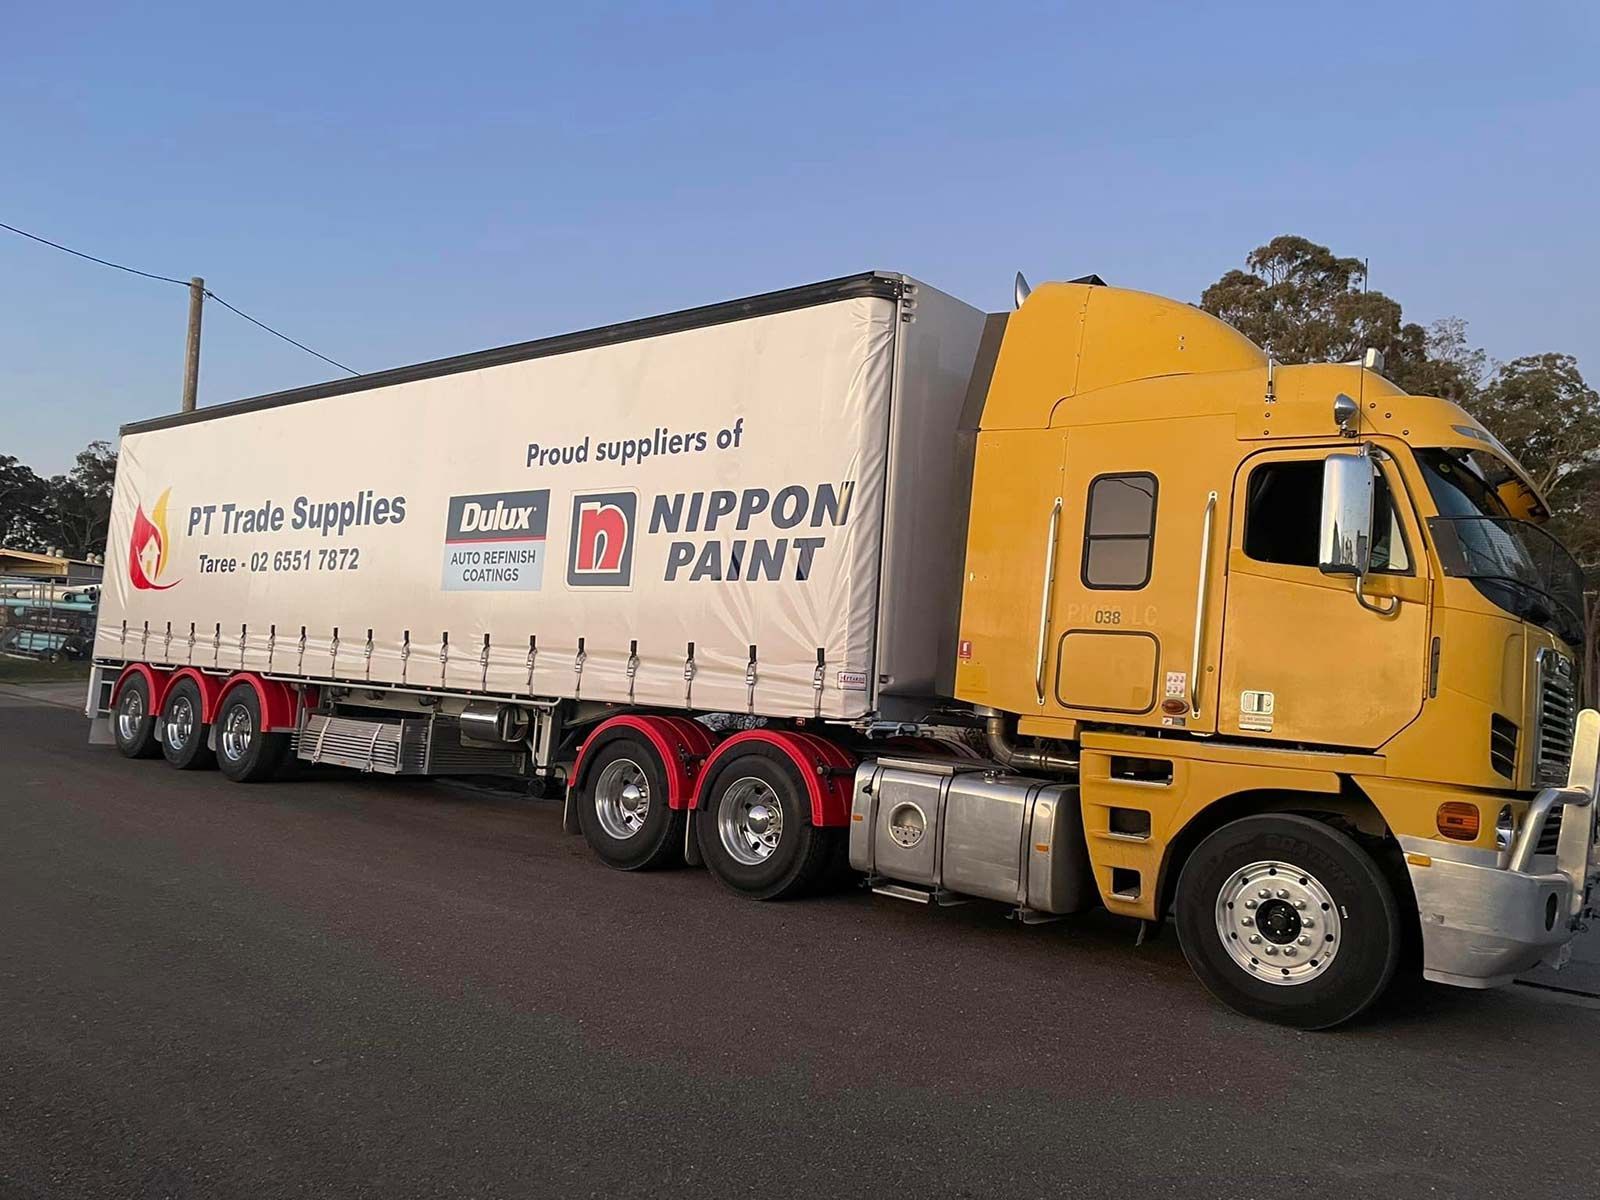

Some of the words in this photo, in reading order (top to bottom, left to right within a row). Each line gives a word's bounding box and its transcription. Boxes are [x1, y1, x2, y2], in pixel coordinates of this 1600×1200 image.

[526, 436, 589, 468] Proud
[595, 428, 707, 466] suppliers
[716, 418, 744, 448] of
[187, 505, 216, 537] PT
[221, 500, 284, 535] Trade
[291, 490, 406, 537] Supplies
[459, 500, 533, 533] Dulux
[648, 481, 856, 534] NIPPON
[199, 554, 237, 573] Taree
[250, 551, 268, 572] 02
[273, 549, 312, 572] 6551
[318, 547, 360, 571] 7872
[450, 551, 481, 566] AUTO
[482, 549, 536, 565] REFINISH
[663, 537, 826, 582] PAINT
[462, 567, 519, 582] COATINGS
[1095, 610, 1121, 624] 038
